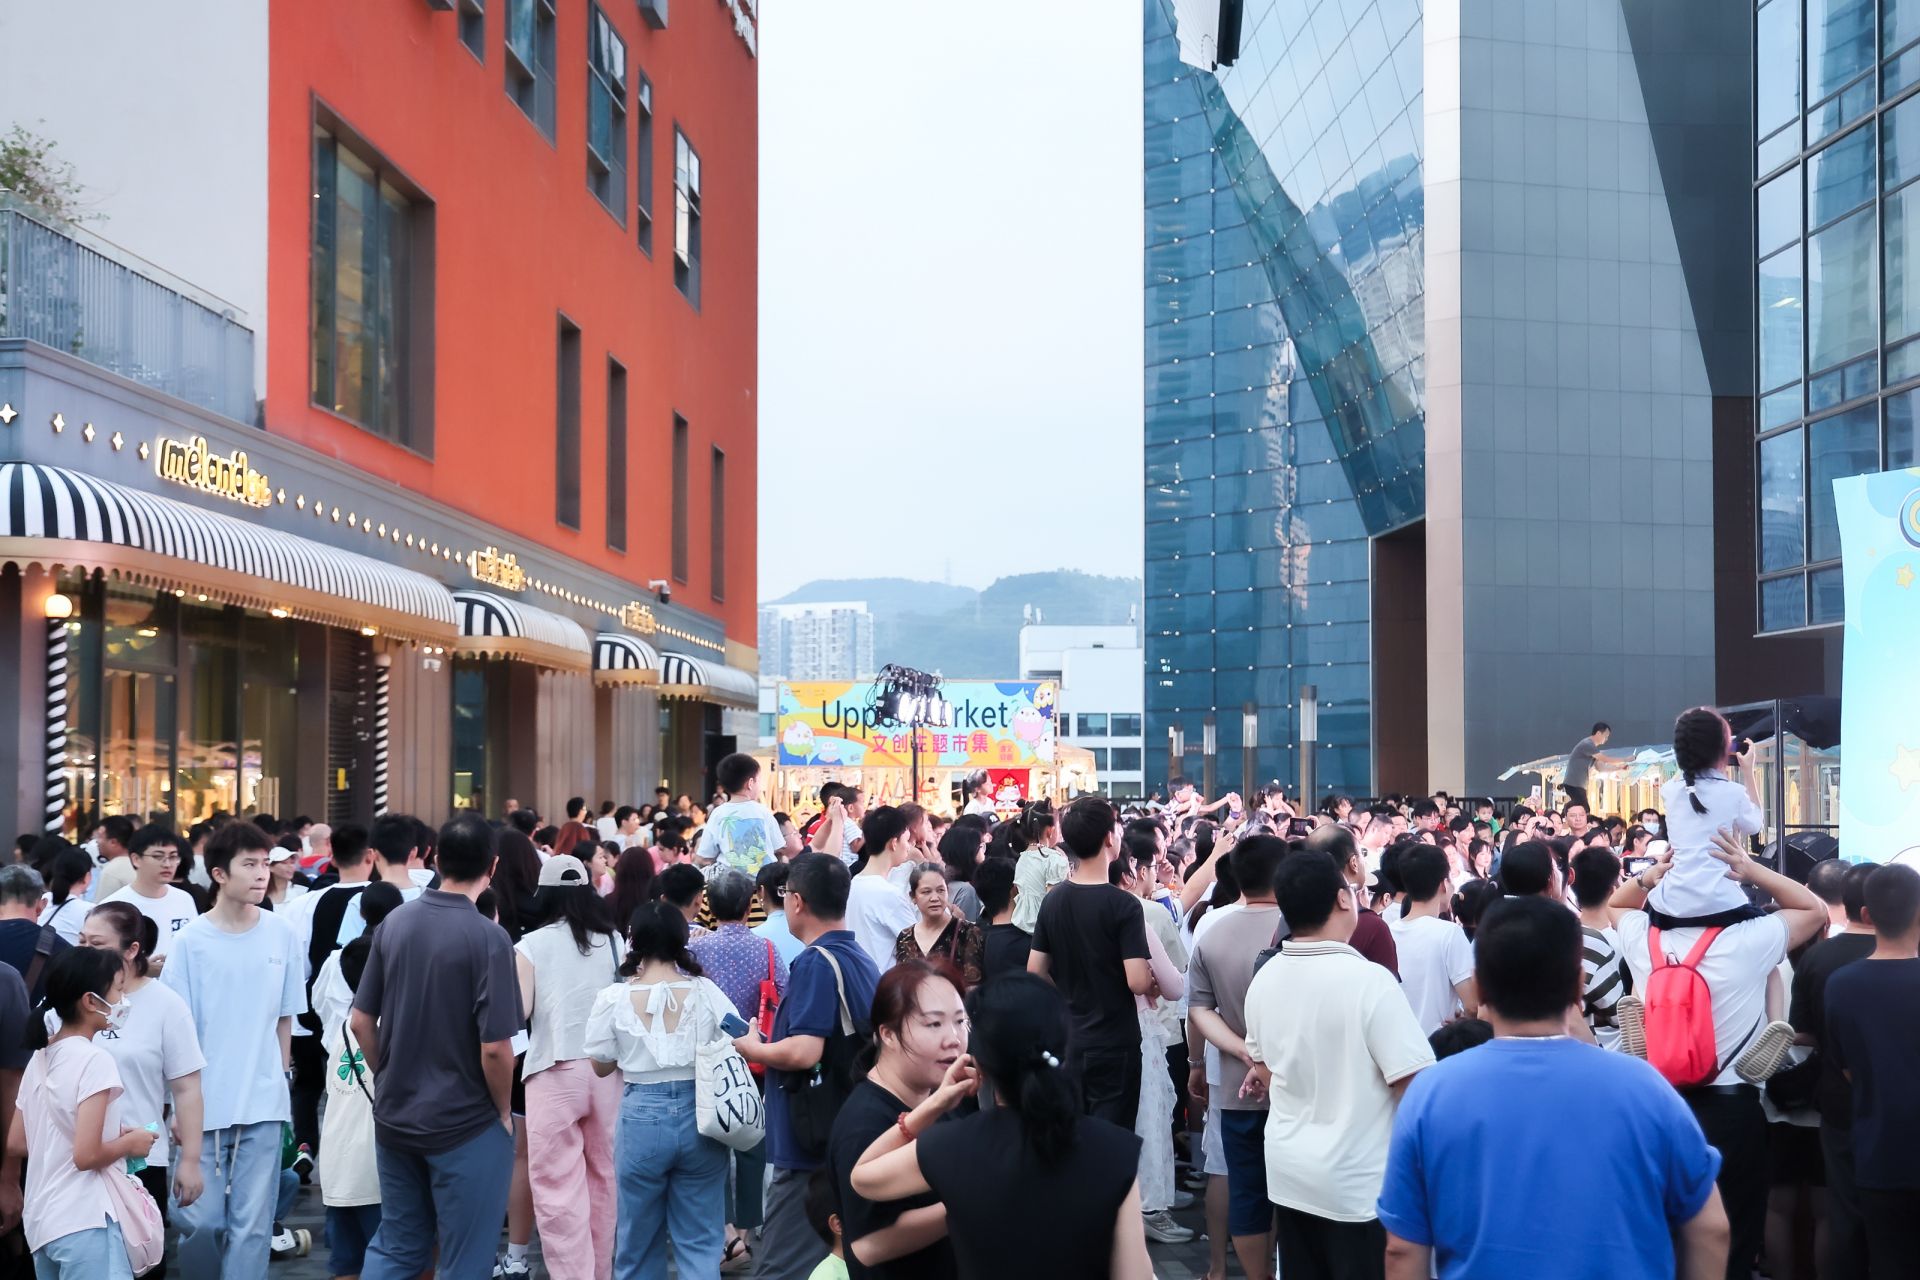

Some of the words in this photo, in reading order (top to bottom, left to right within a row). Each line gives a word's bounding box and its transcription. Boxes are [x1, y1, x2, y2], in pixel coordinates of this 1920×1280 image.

[872, 733, 988, 753] 文创主题市集
